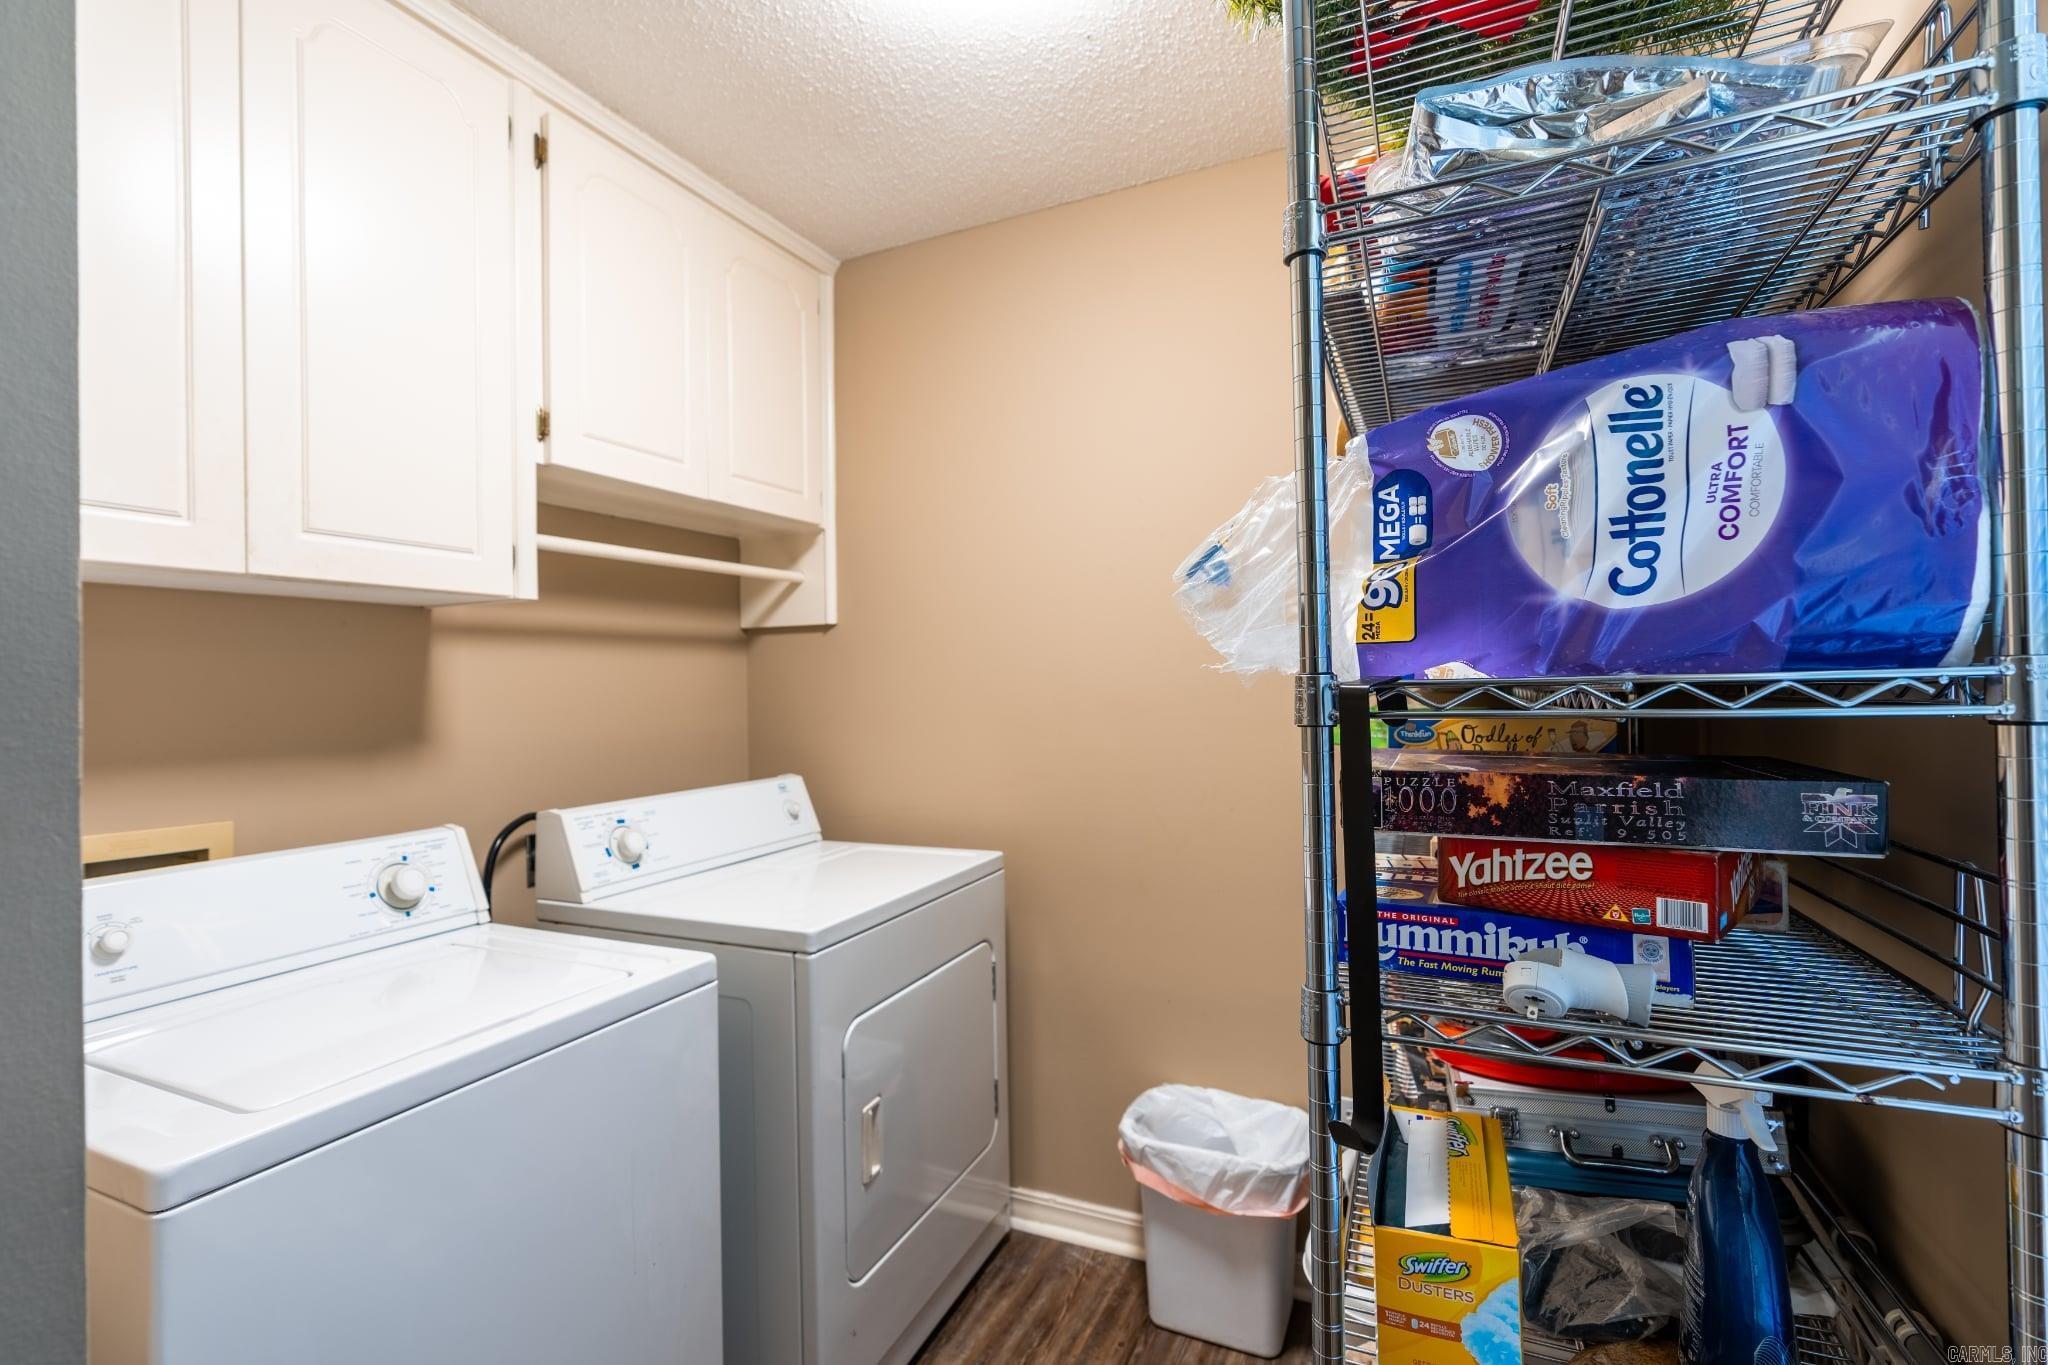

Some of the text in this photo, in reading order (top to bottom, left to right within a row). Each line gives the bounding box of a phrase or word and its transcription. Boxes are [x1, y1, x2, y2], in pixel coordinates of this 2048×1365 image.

[1473, 417, 1497, 436] FRESH
[1478, 433, 1500, 469] SHOWER
[1705, 461, 1723, 503] ULTRA
[1718, 425, 1750, 541] COMFORT
[1748, 441, 1764, 517] COMFORTABLE
[1544, 484, 1558, 510] Soft
[1608, 384, 1665, 597] Cottonelle
[1377, 483, 1401, 561] MEGA
[1461, 723, 1520, 744] Oodles
[1526, 726, 1543, 748] of
[1383, 777, 1456, 787] PUZZLE
[1547, 780, 1684, 799] Maxfield
[1383, 786, 1457, 814] 1000
[1547, 797, 1686, 816] Parrish
[1801, 801, 1879, 818] FINK
[1619, 815, 1686, 831] Valley
[1814, 815, 1879, 825] COMPANY
[1448, 847, 1594, 888] Yahtzee
[1378, 911, 1456, 925] THE ORIGINAL
[1397, 956, 1415, 967] The
[1418, 959, 1438, 970] Fast
[1441, 961, 1478, 977] Moving
[1655, 985, 1680, 993] players
[1402, 1256, 1466, 1276] Swiffer
[1398, 1276, 1475, 1304] DUSTERS
[1419, 1321, 1430, 1329] 24
